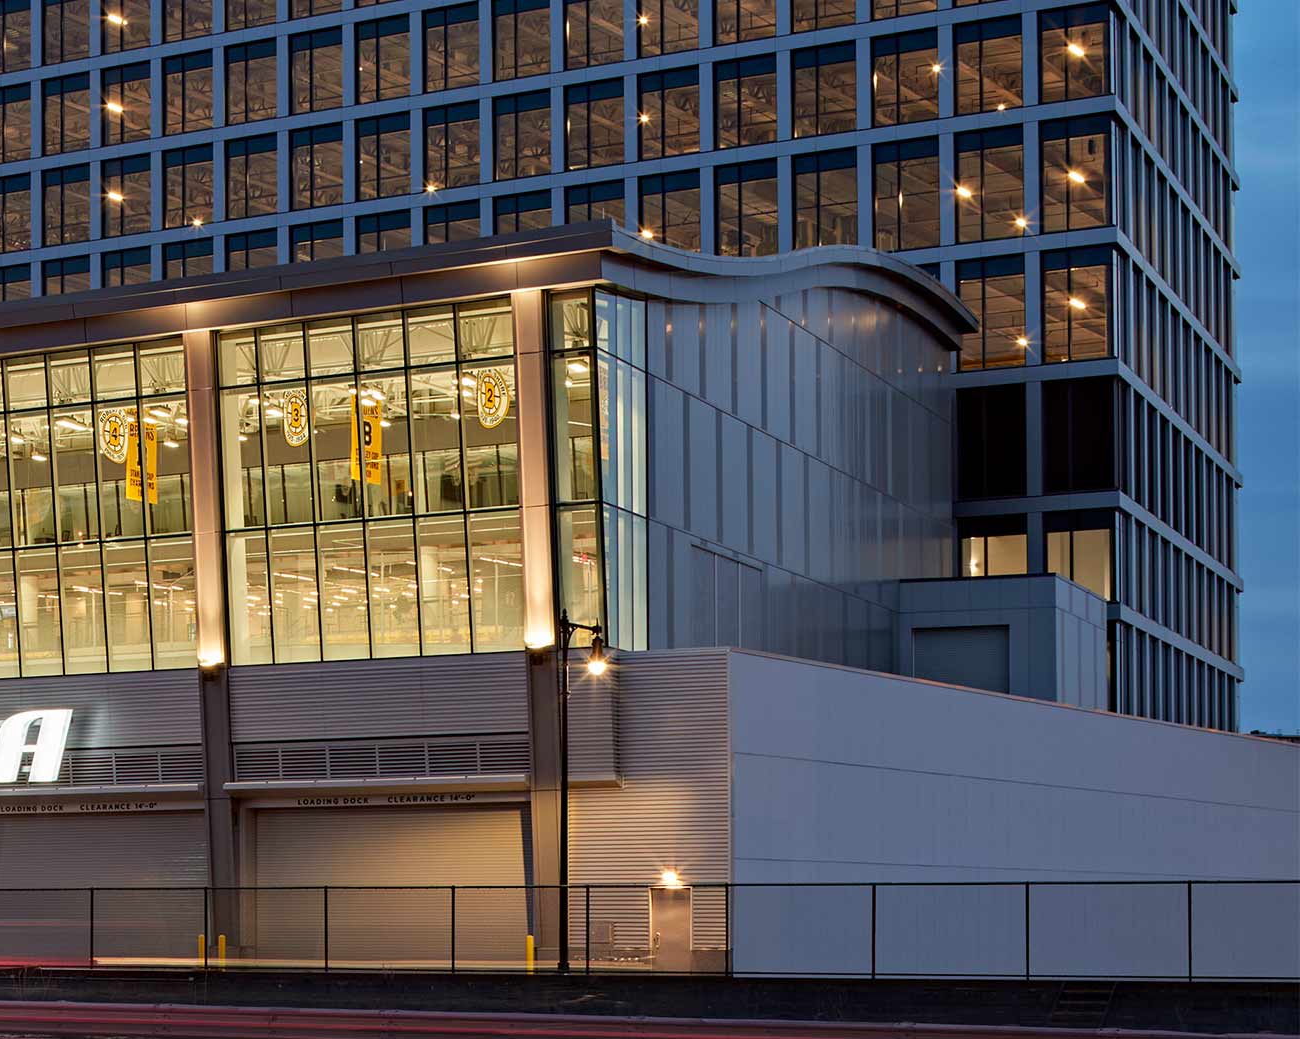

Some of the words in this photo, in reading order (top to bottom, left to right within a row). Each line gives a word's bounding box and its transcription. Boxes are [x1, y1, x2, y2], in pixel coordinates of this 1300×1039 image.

[487, 388, 494, 403] 2
[293, 408, 300, 422] 3
[111, 427, 118, 441] 4
[297, 798, 339, 806] LOADING
[343, 797, 369, 805] DOCK
[387, 794, 445, 804] CLEARANCE
[0, 805, 38, 813] LOADING
[41, 804, 65, 812] DOCK
[79, 803, 131, 811] CLEARANCE
